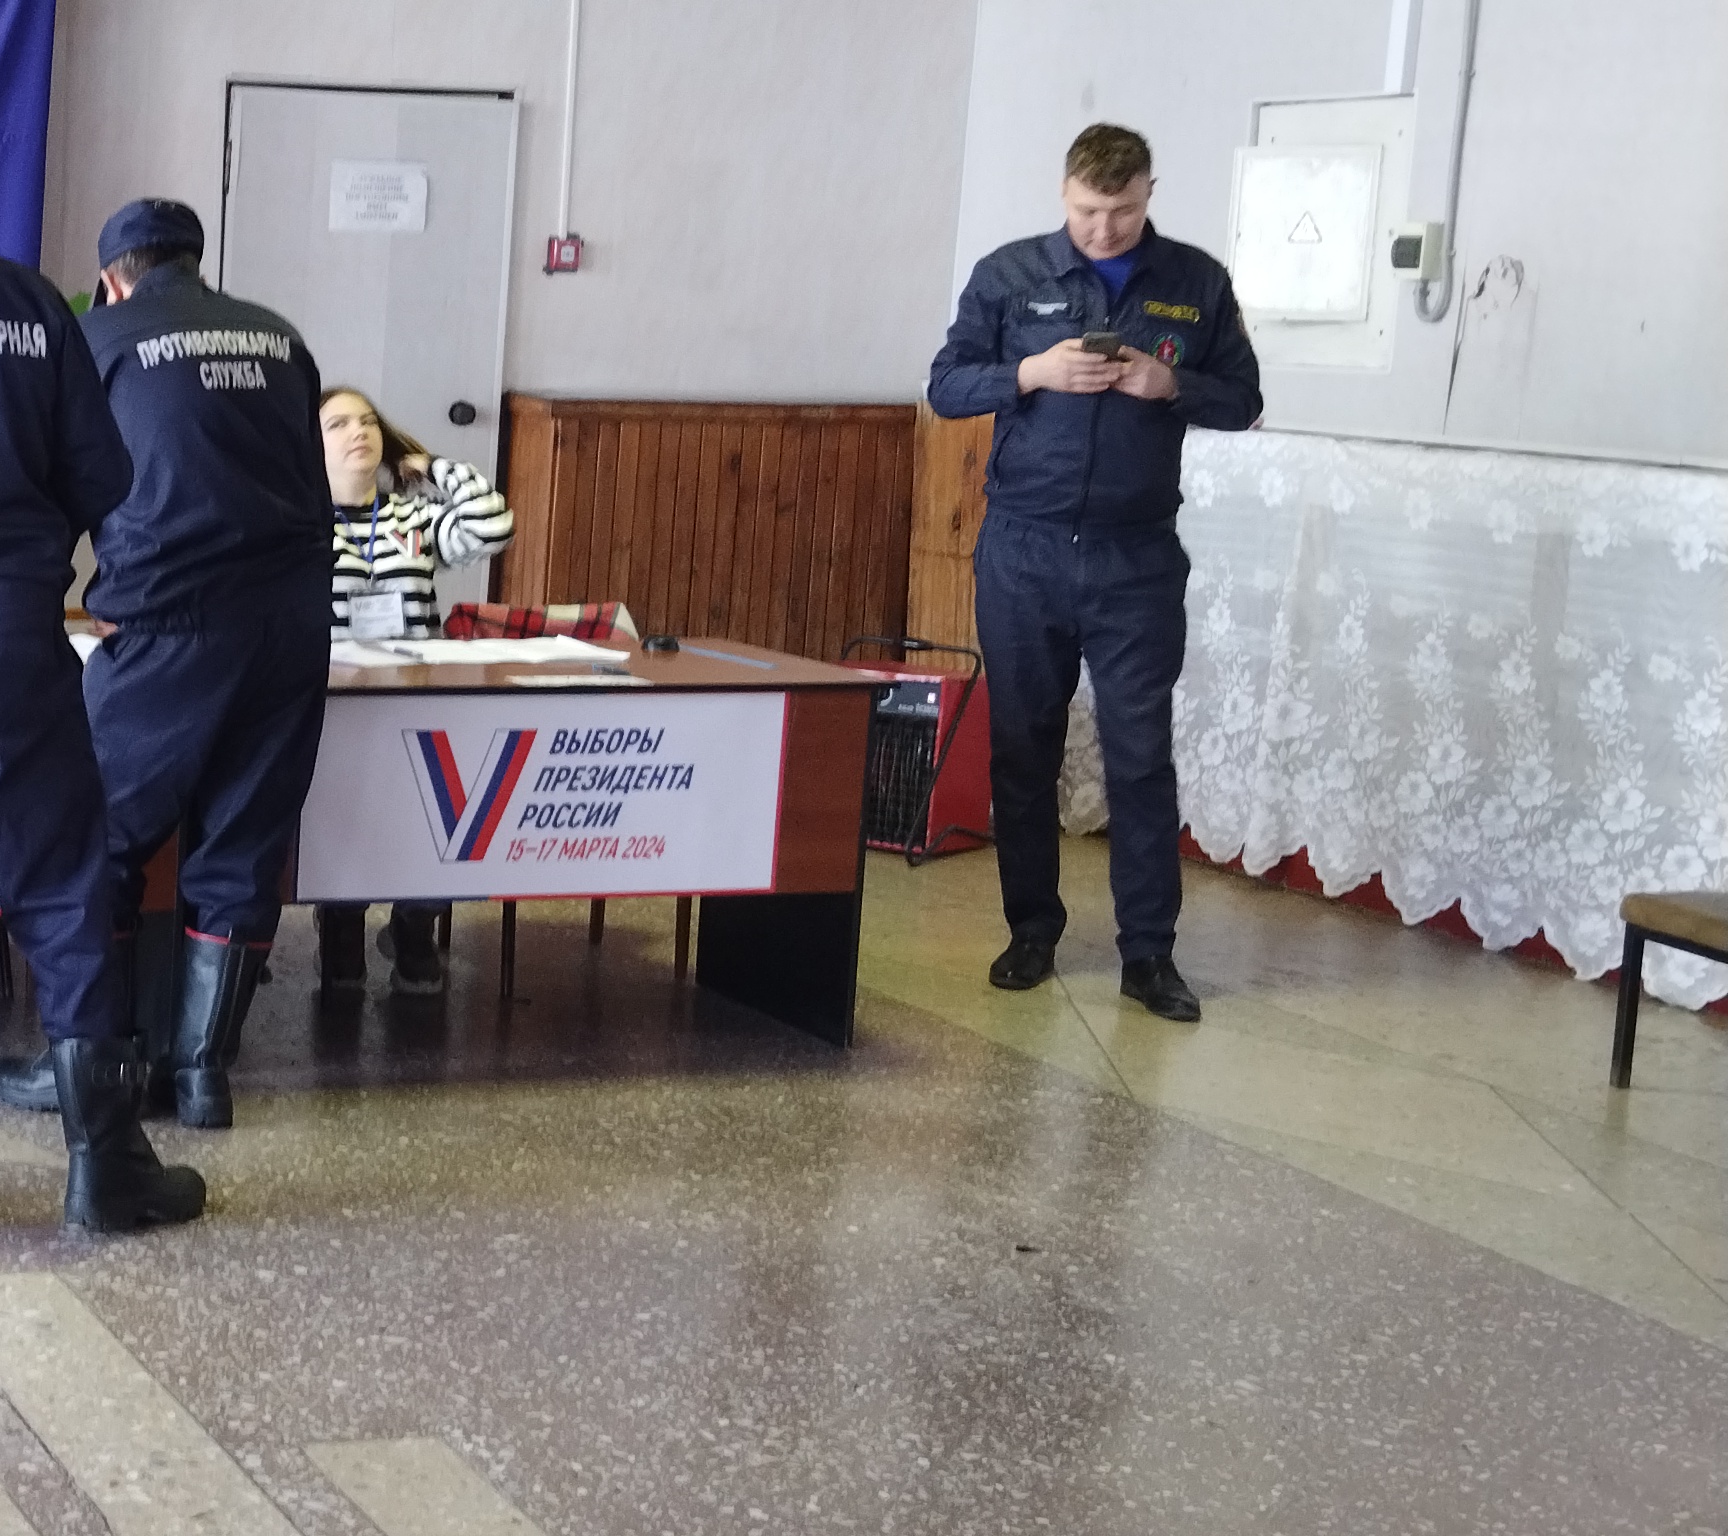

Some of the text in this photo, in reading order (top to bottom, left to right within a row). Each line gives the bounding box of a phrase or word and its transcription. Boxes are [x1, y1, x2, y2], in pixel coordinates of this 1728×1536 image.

[199, 361, 267, 390] СЛУЖБА
[549, 727, 665, 755] ВЫБОРЫ
[533, 763, 695, 795] ПРЕЗИДЕНТА
[517, 801, 624, 830] РОССИИ
[558, 836, 620, 861] МАРТА
[621, 835, 667, 860] 2024
